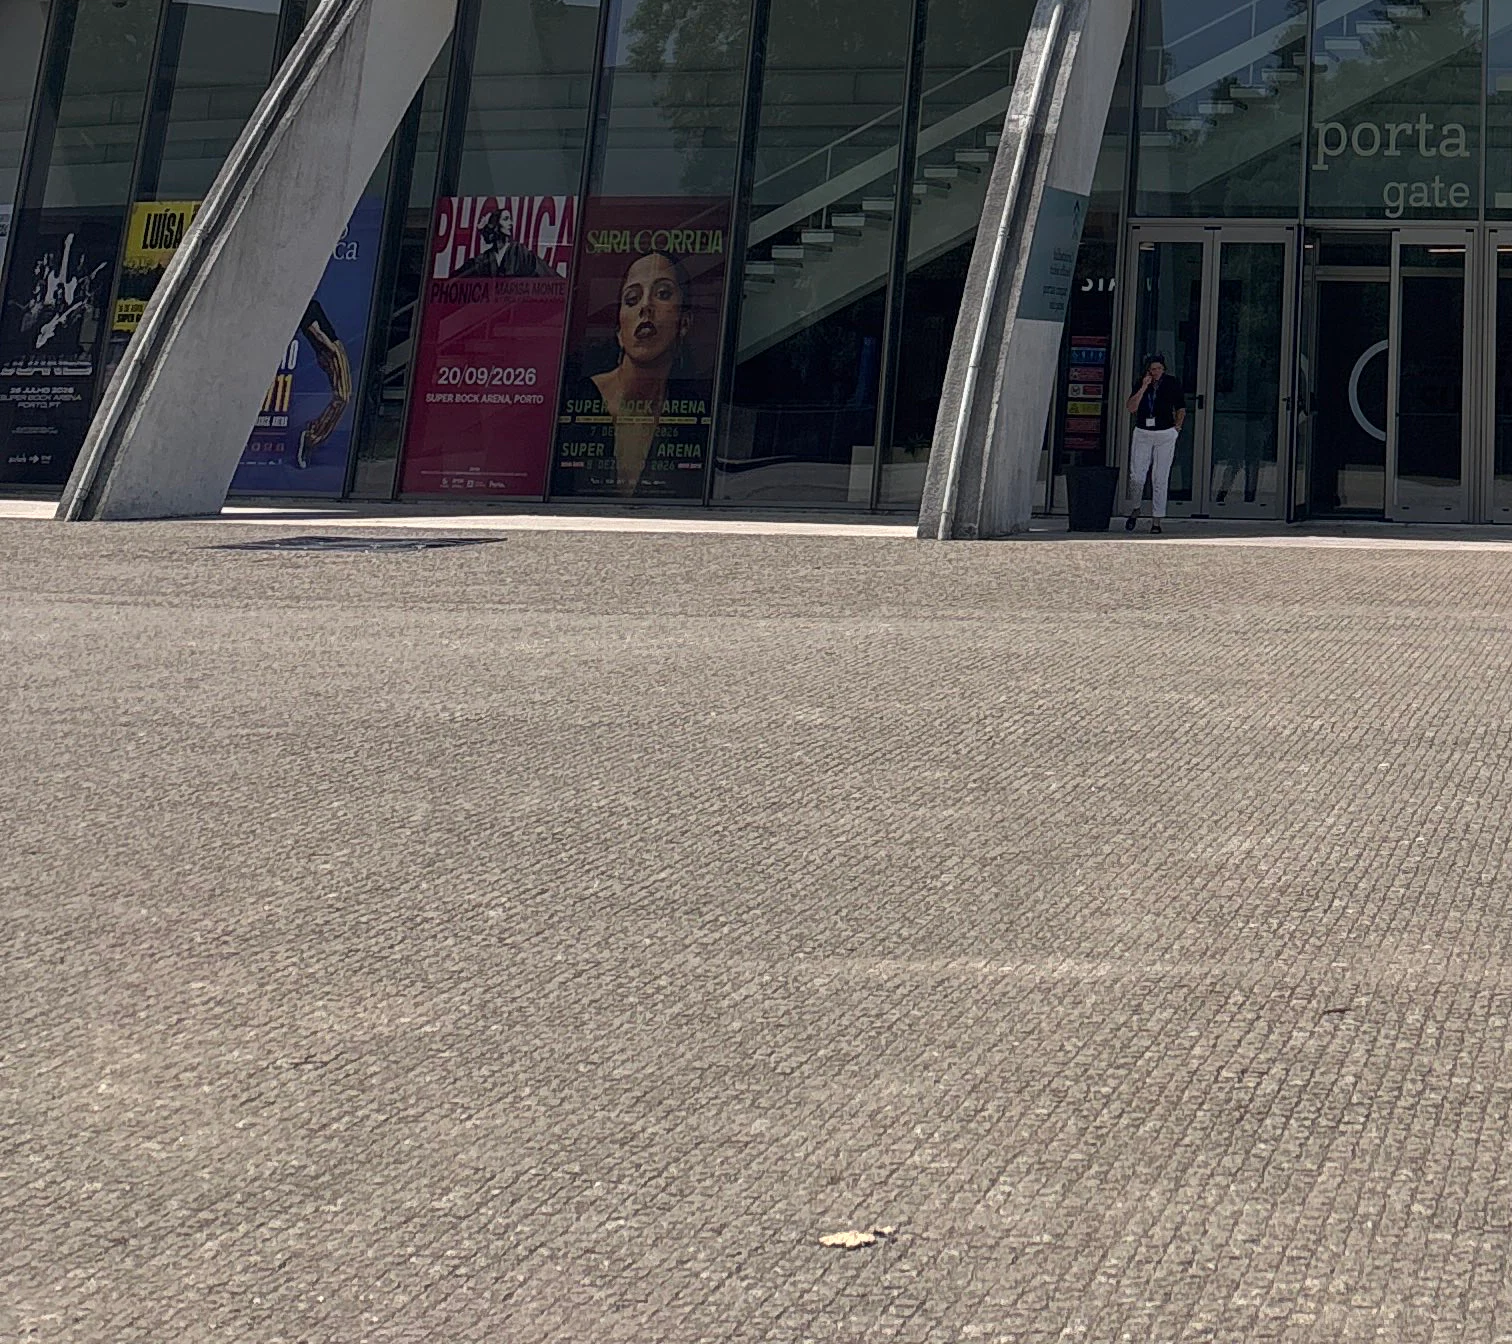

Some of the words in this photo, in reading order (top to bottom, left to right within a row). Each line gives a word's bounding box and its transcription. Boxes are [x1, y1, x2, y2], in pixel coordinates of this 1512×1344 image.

[1312, 113, 1470, 170] porta
[1383, 176, 1470, 218] gate
[142, 208, 184, 249] LUÍSA
[586, 229, 631, 253] SARA
[634, 229, 722, 253] CORREIA
[430, 282, 489, 304] PHONICA
[533, 283, 565, 296] MONTE
[437, 364, 536, 388] 20/09/2026
[425, 393, 453, 403] SUPER
[455, 393, 479, 403] BOCK
[513, 394, 544, 404] PORTO
[567, 399, 609, 413] SUPER
[662, 400, 706, 414] ARENA
[561, 442, 605, 457] SUPER
[657, 443, 702, 457] ARENA
